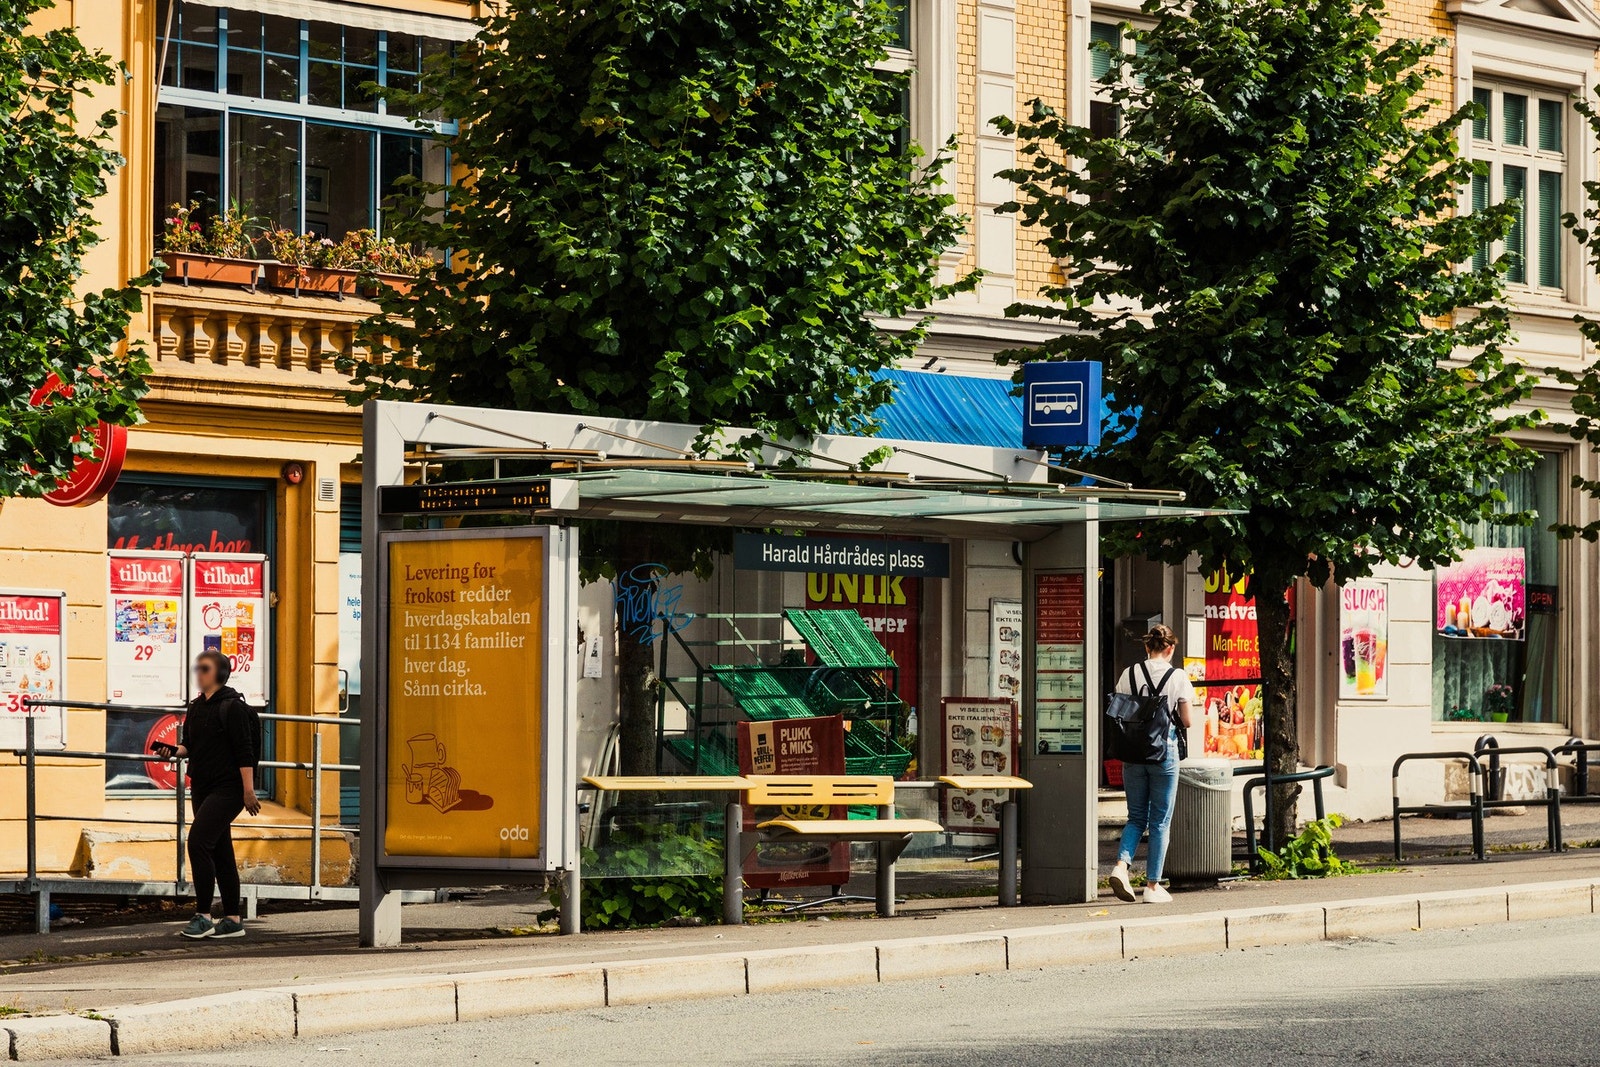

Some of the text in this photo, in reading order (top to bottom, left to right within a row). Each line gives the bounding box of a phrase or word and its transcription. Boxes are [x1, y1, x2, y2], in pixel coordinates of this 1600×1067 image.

[763, 543, 925, 571] Harald Hårdrådes plass
[119, 564, 173, 583] tilbud!
[203, 566, 255, 586] tilbud!
[405, 562, 497, 583] Levering før
[405, 585, 512, 604] frokost redder
[1344, 587, 1385, 611] SLUSH
[1531, 592, 1553, 605] OPEN
[405, 609, 531, 630] hverdagskabalen
[404, 632, 526, 650] til 1134 familier
[1213, 635, 1253, 652] Man-fre:
[135, 645, 154, 661] 29
[404, 656, 471, 677] hver dag.
[404, 679, 488, 697] Sånn cirka.
[781, 727, 811, 742] PLUKK
[781, 741, 815, 755] & MIKS
[500, 825, 529, 841] oda
